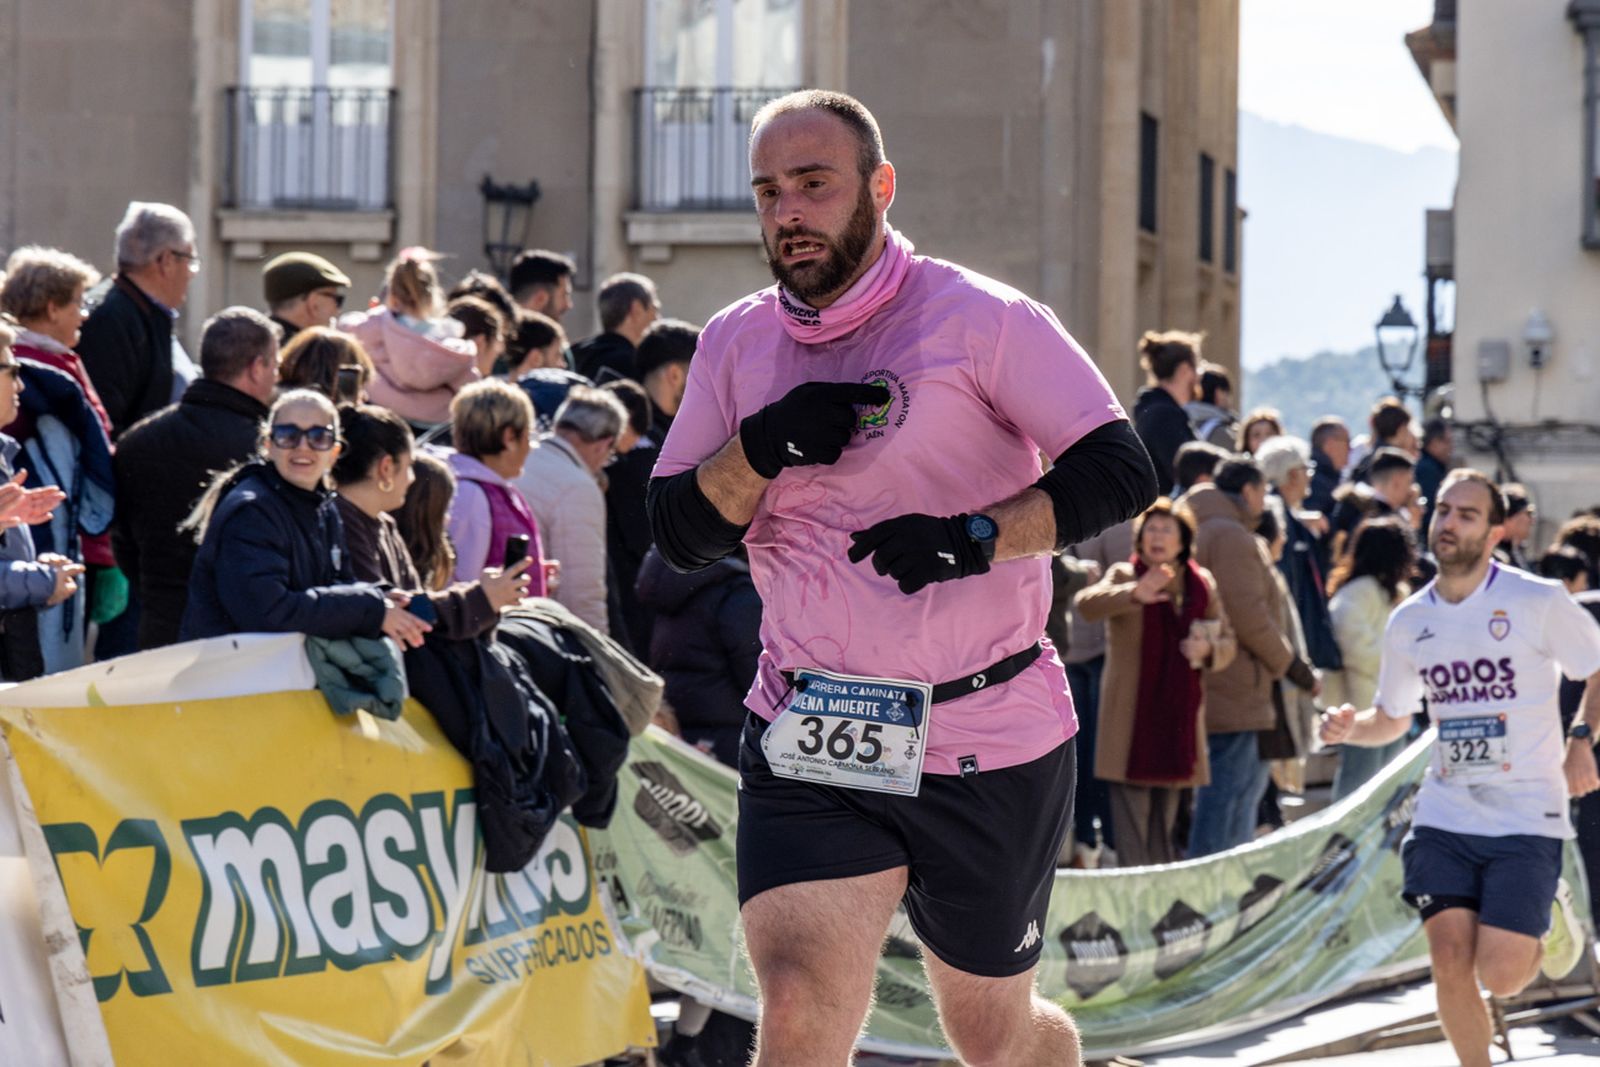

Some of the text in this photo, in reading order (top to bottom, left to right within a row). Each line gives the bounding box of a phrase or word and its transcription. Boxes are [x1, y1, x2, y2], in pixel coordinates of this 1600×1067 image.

[894, 382, 910, 428] MARATON
[808, 681, 907, 701] ARRERA CAMINATA
[793, 695, 880, 717] UENA MUERTE
[797, 716, 883, 764] 365
[1449, 739, 1491, 763] 322
[779, 751, 796, 761] JOSÉ
[797, 754, 828, 767] ANTONIO
